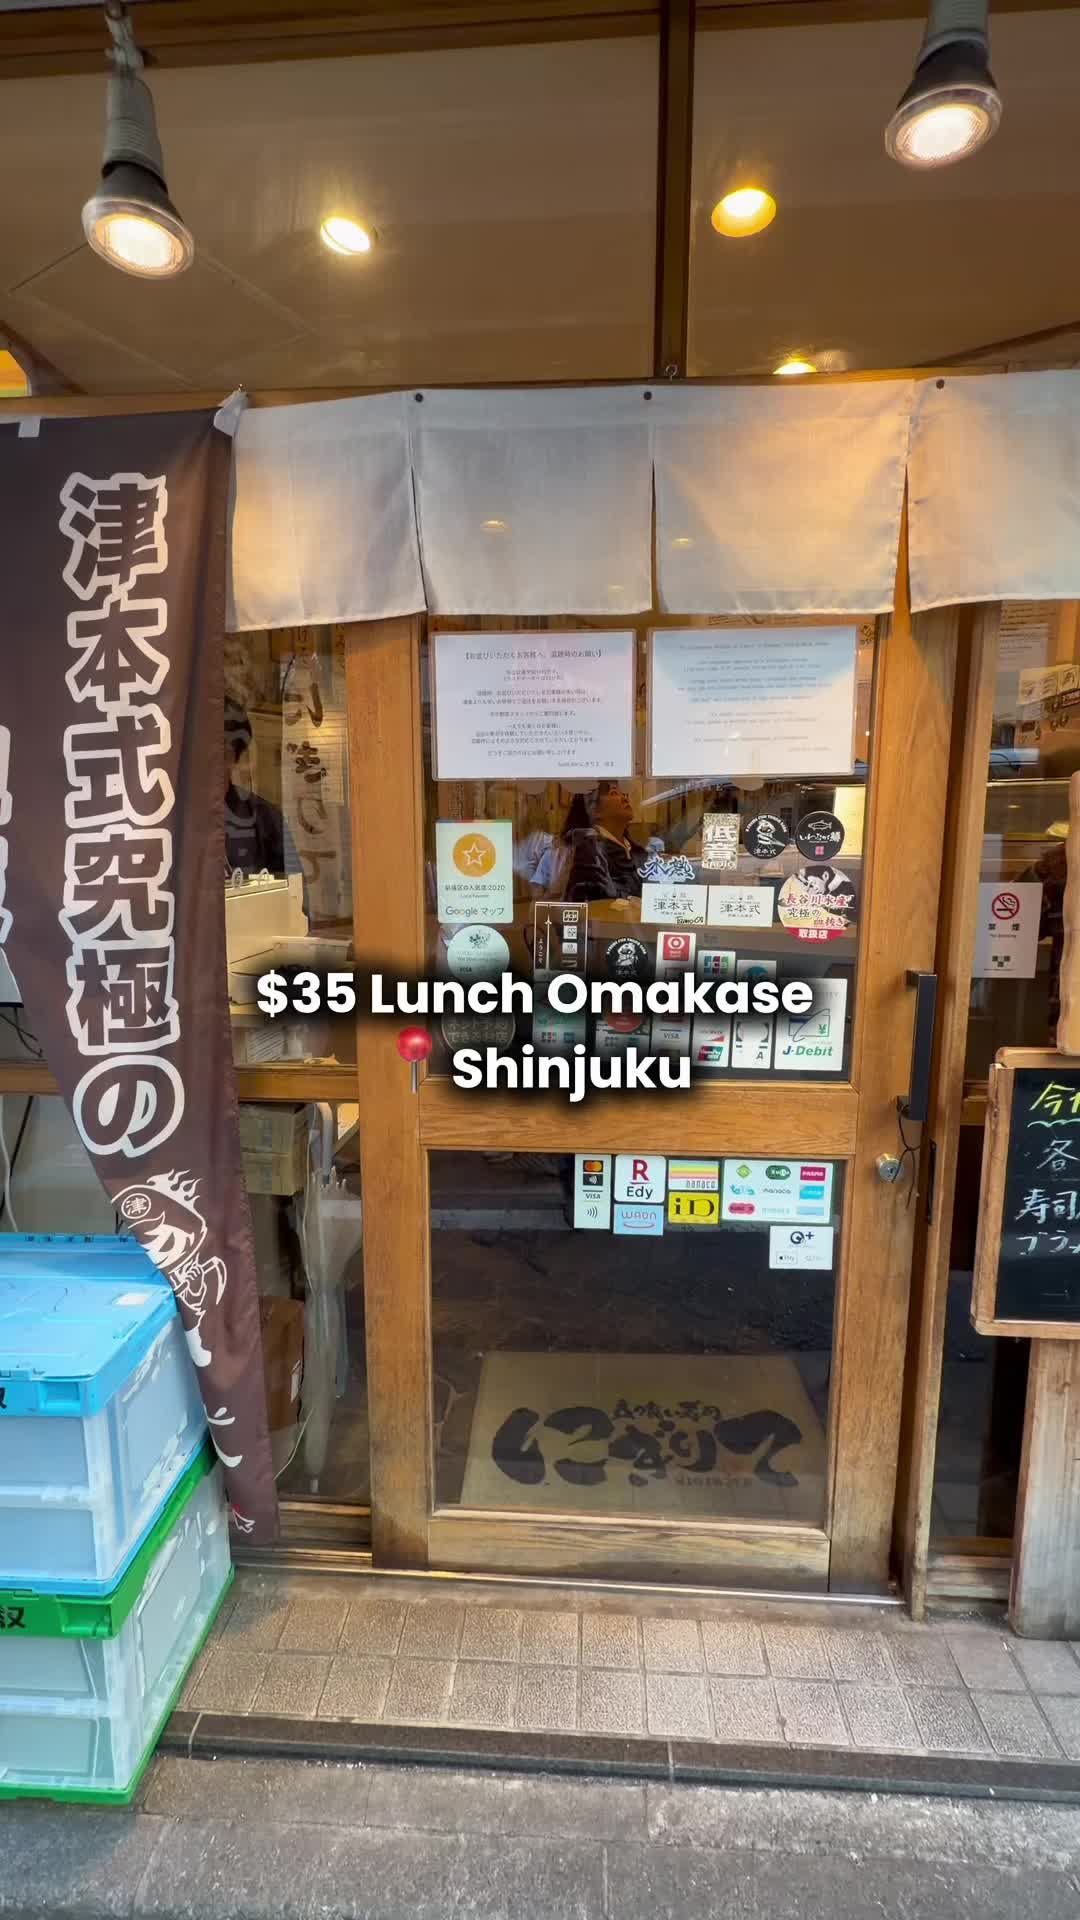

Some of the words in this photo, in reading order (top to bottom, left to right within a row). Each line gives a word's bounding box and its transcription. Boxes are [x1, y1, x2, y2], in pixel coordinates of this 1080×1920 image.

[59, 472, 185, 1158] 津本式究極の
[786, 892, 849, 907] 長谷川水産
[445, 905, 478, 918] Google
[480, 907, 505, 917] マップ
[654, 901, 695, 913] 津本式
[720, 903, 761, 915] 津本式
[787, 907, 821, 918] 究極の
[798, 928, 829, 939] 取扱店
[782, 1045, 833, 1057] J-Debit
[632, 1159, 650, 1182] R
[686, 1180, 716, 1189] nanaco
[626, 1185, 654, 1200] Edy
[674, 1197, 715, 1217] iD
[1015, 1188, 1080, 1225] 寿司
